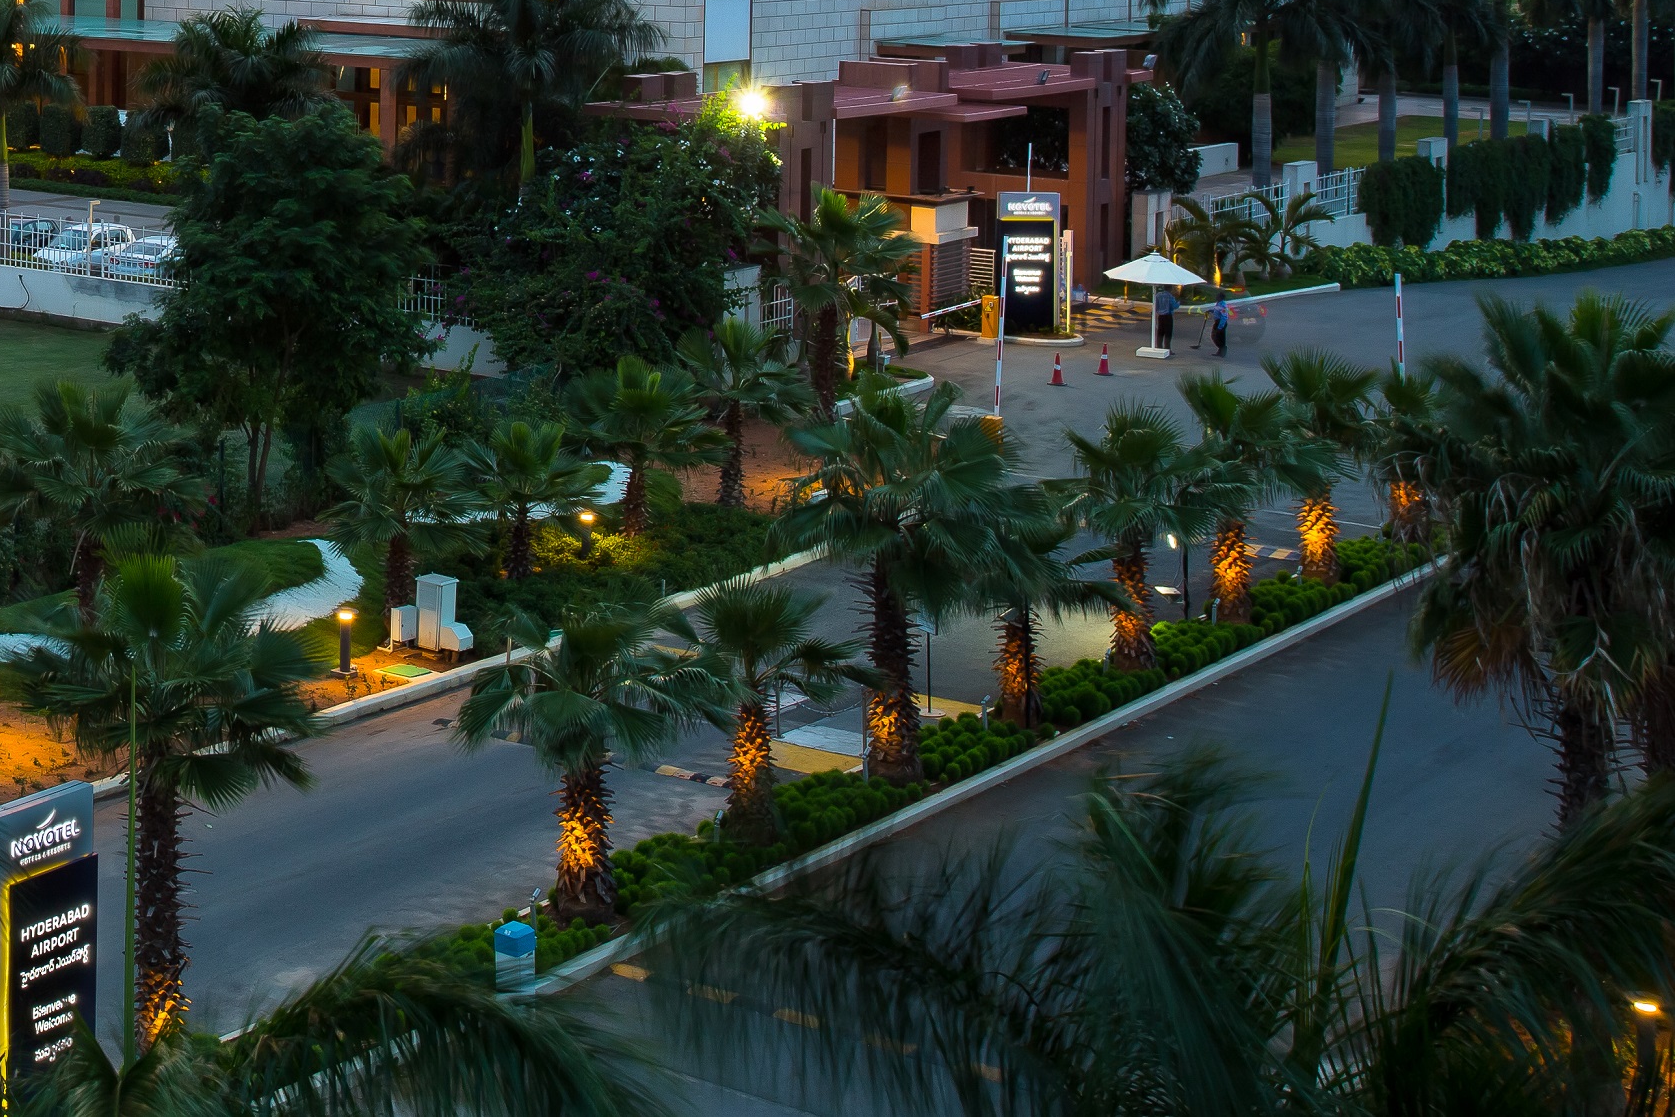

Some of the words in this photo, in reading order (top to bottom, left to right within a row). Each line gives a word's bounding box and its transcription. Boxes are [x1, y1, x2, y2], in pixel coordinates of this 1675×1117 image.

[1007, 202, 1053, 212] NOVOTEL
[10, 818, 81, 858] NOVOTEL
[21, 904, 90, 942] HYDERABAD
[31, 927, 80, 958] AIRPORT
